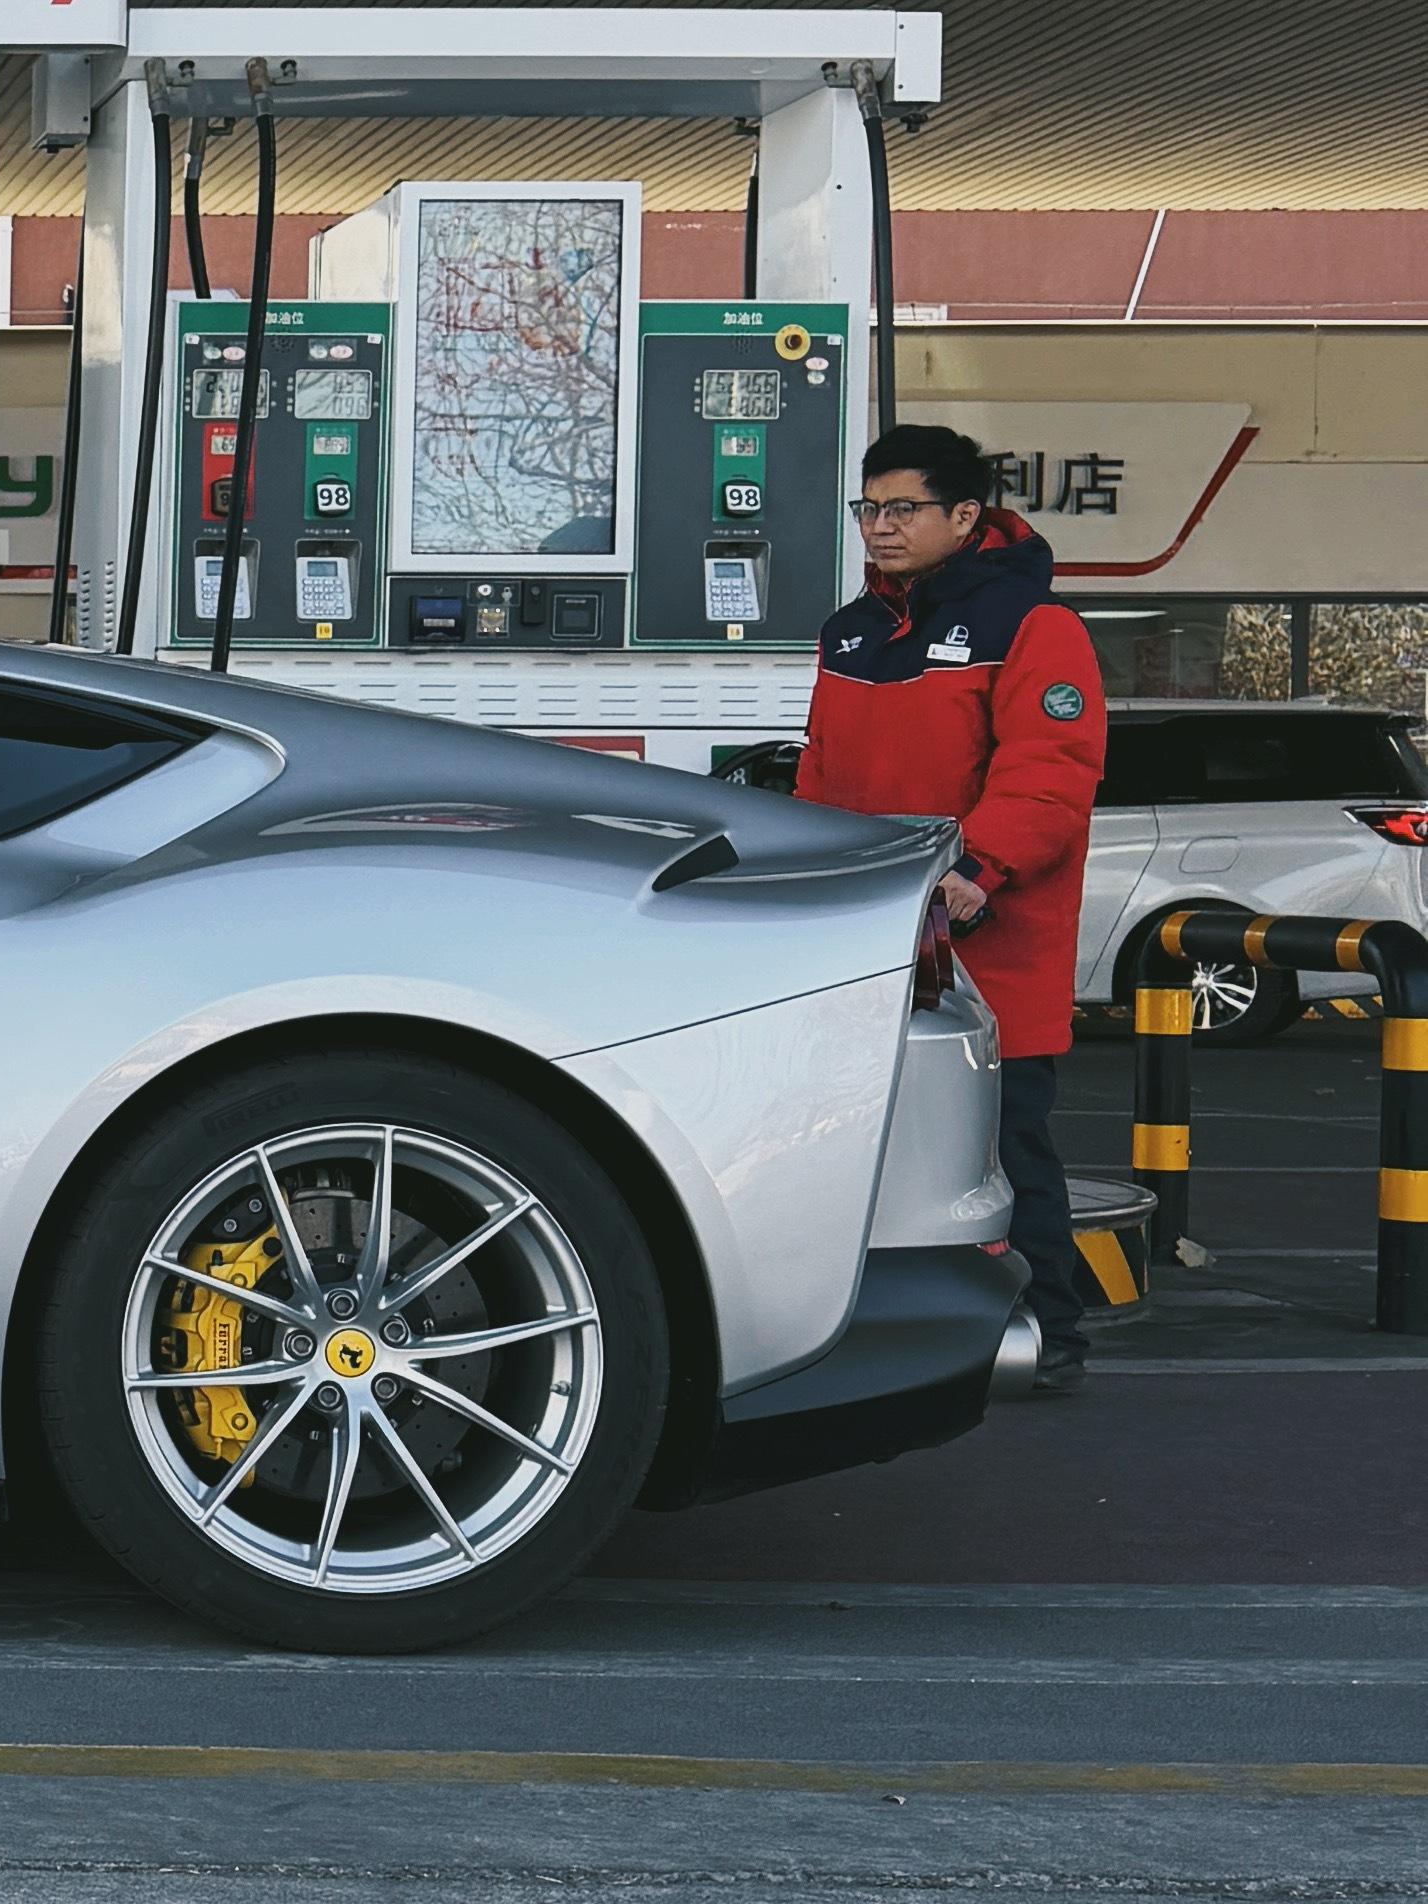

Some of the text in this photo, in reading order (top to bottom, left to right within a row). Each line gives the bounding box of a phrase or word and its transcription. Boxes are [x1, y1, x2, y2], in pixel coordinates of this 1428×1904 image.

[265, 311, 304, 325] 加油位
[722, 311, 763, 325] 加油位
[983, 451, 1125, 515] 利店
[318, 487, 349, 507] 98
[729, 488, 759, 507] 98
